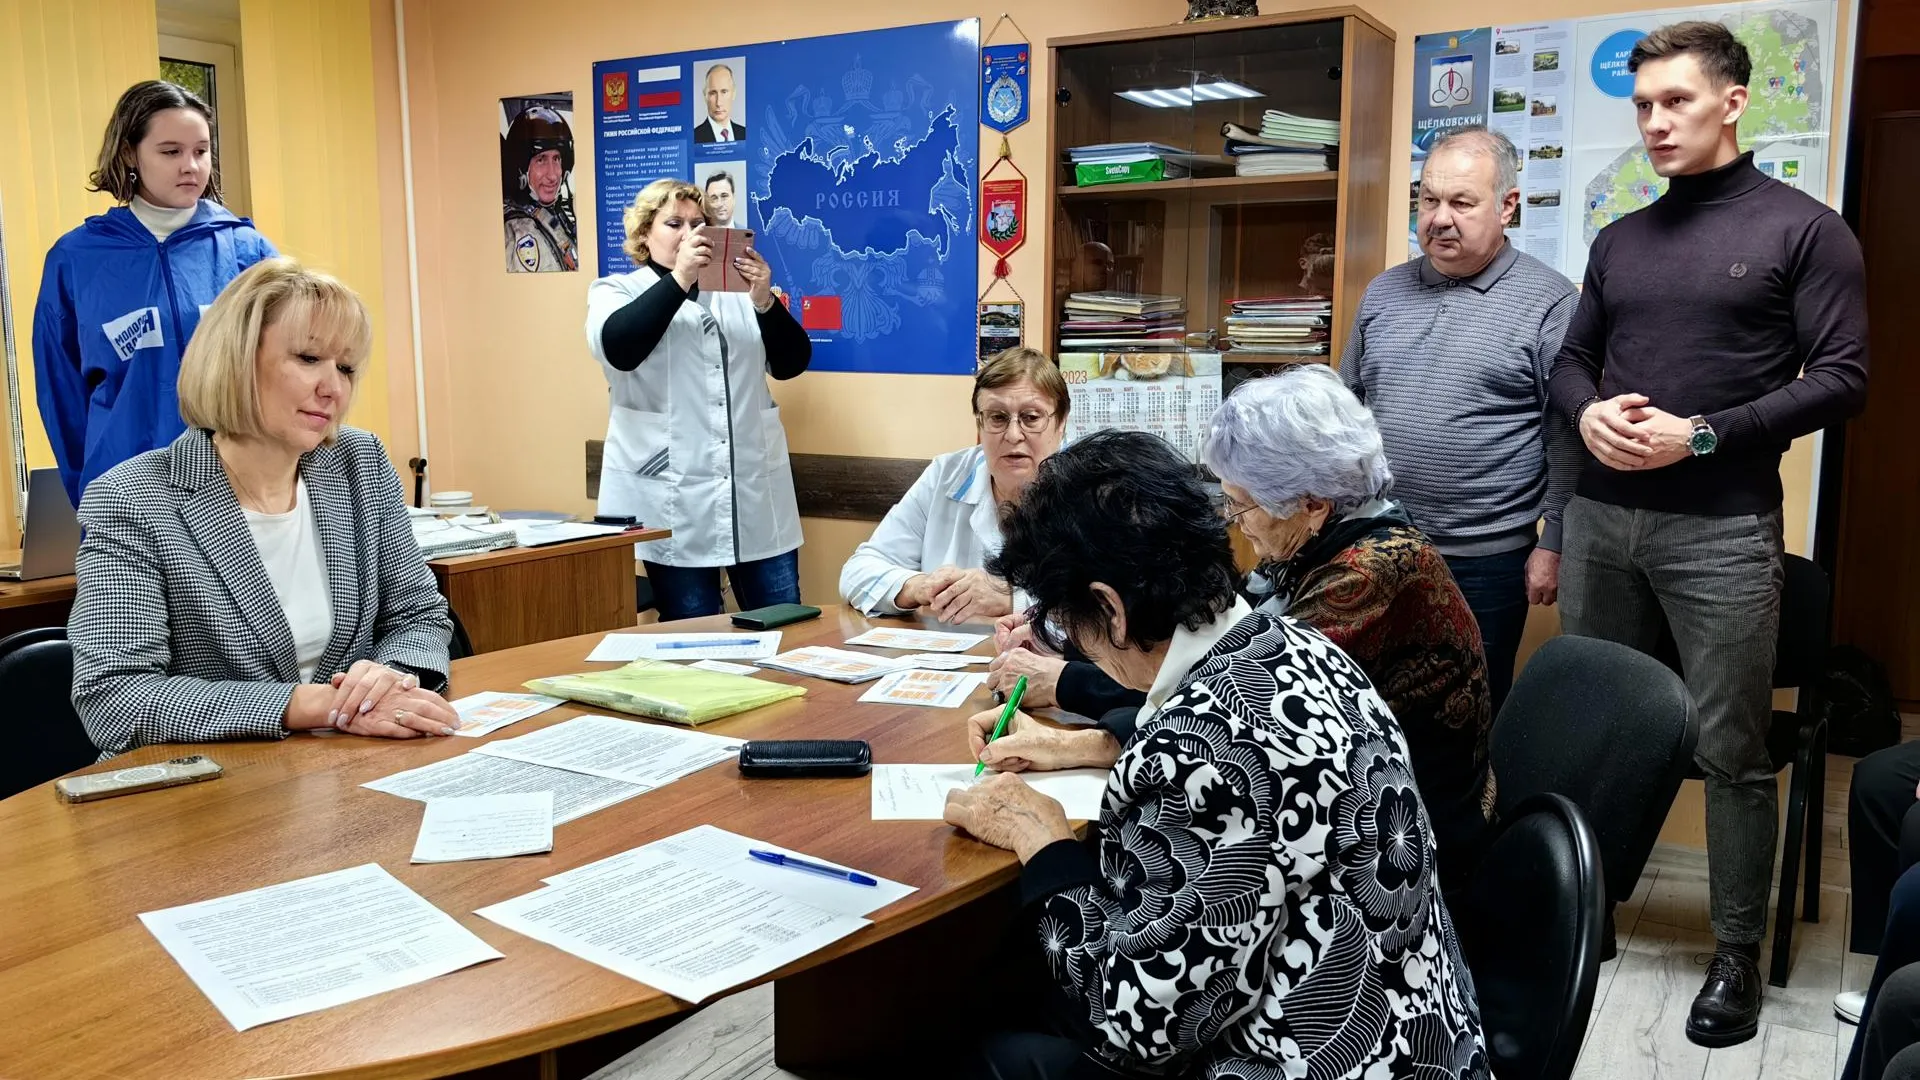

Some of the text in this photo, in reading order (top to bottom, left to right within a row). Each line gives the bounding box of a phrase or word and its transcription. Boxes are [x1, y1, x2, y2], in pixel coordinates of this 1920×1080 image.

[1616, 50, 1632, 58] КАРТ
[1418, 114, 1482, 130] ЩЁЛКОВСКИЙ
[618, 127, 651, 137] РОССИЙСКОЙ
[652, 126, 682, 134] ФЕДЕРАЦИИ
[816, 190, 901, 209] РОССИЯ
[1063, 371, 1088, 384] 2023
